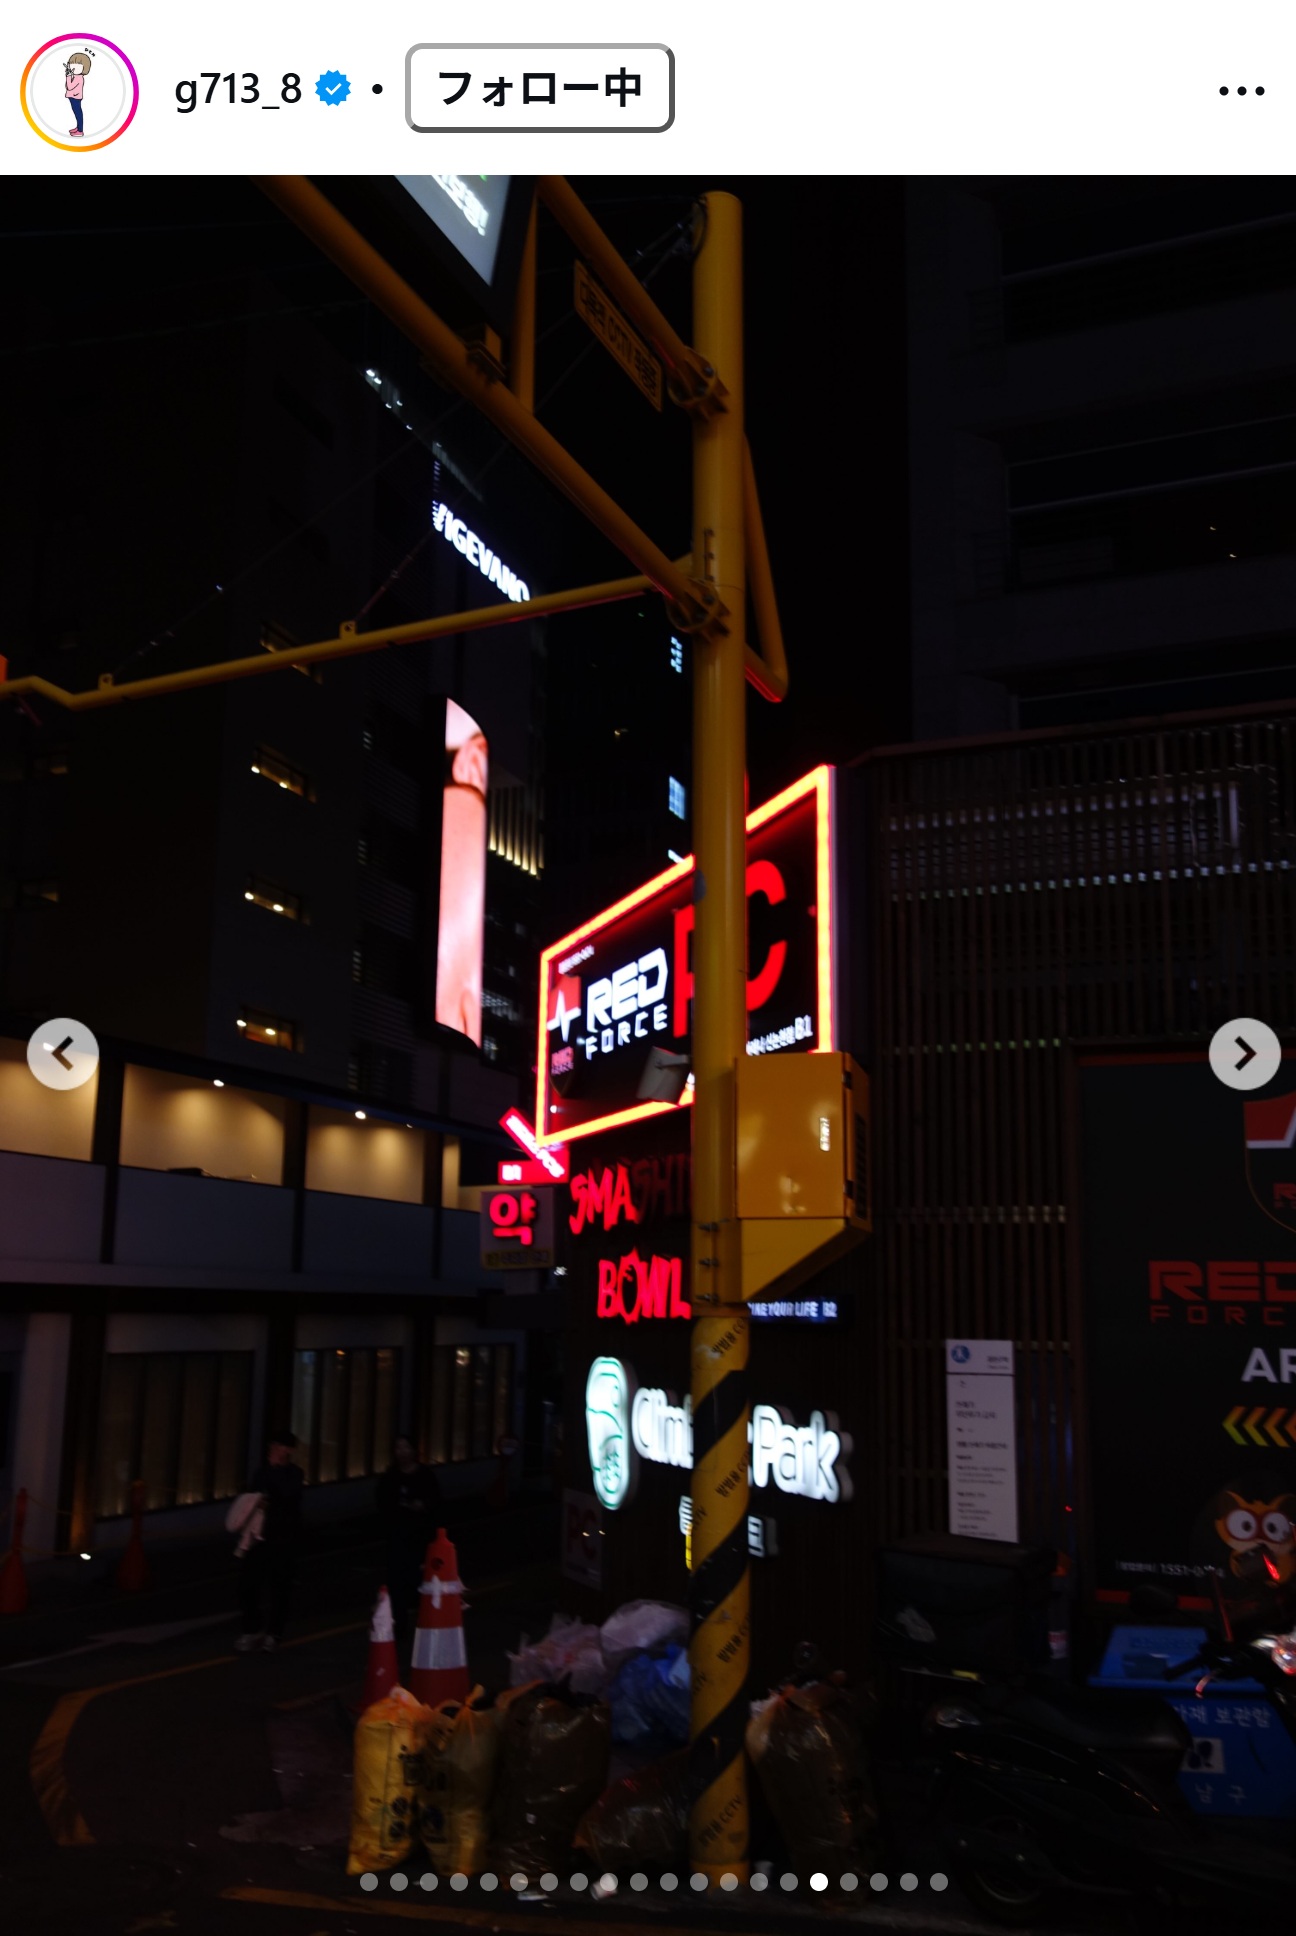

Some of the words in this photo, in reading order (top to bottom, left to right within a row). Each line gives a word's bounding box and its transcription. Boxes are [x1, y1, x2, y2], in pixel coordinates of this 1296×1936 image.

[586, 946, 669, 1034] RED
[585, 1003, 669, 1061] FORCE
[489, 1192, 537, 1246] 약
[596, 1246, 692, 1325] BOWL
[767, 1301, 794, 1317] YOUR
[795, 1301, 819, 1318] LIFE
[752, 1404, 840, 1503] Park
